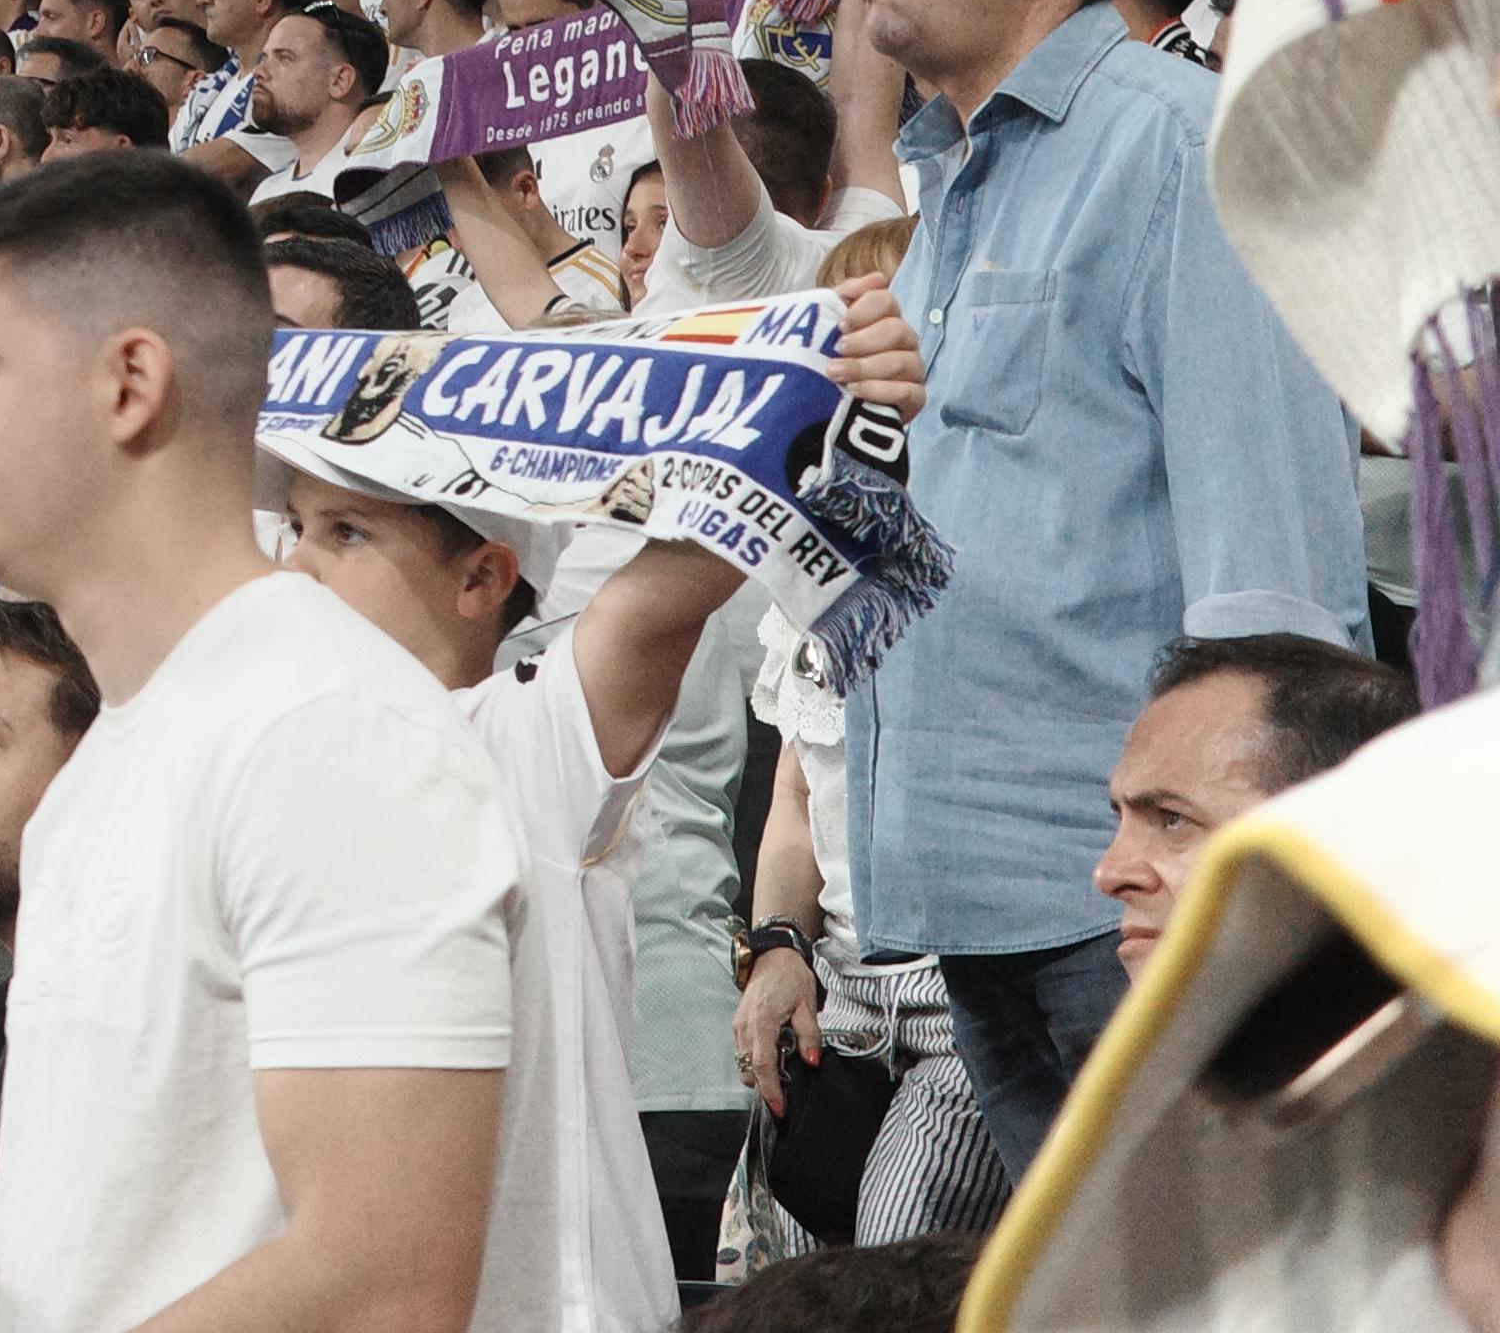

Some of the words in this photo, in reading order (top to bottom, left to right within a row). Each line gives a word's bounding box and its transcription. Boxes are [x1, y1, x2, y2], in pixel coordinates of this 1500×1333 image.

[494, 28, 553, 60] Peña
[486, 123, 533, 144] Desde
[539, 111, 568, 134] 1975
[575, 95, 631, 127] creando
[552, 204, 617, 233] irates
[266, 334, 368, 407] ANI
[421, 345, 785, 451] CARVAJAL
[737, 489, 795, 544] DEL
[787, 532, 850, 589] REY
